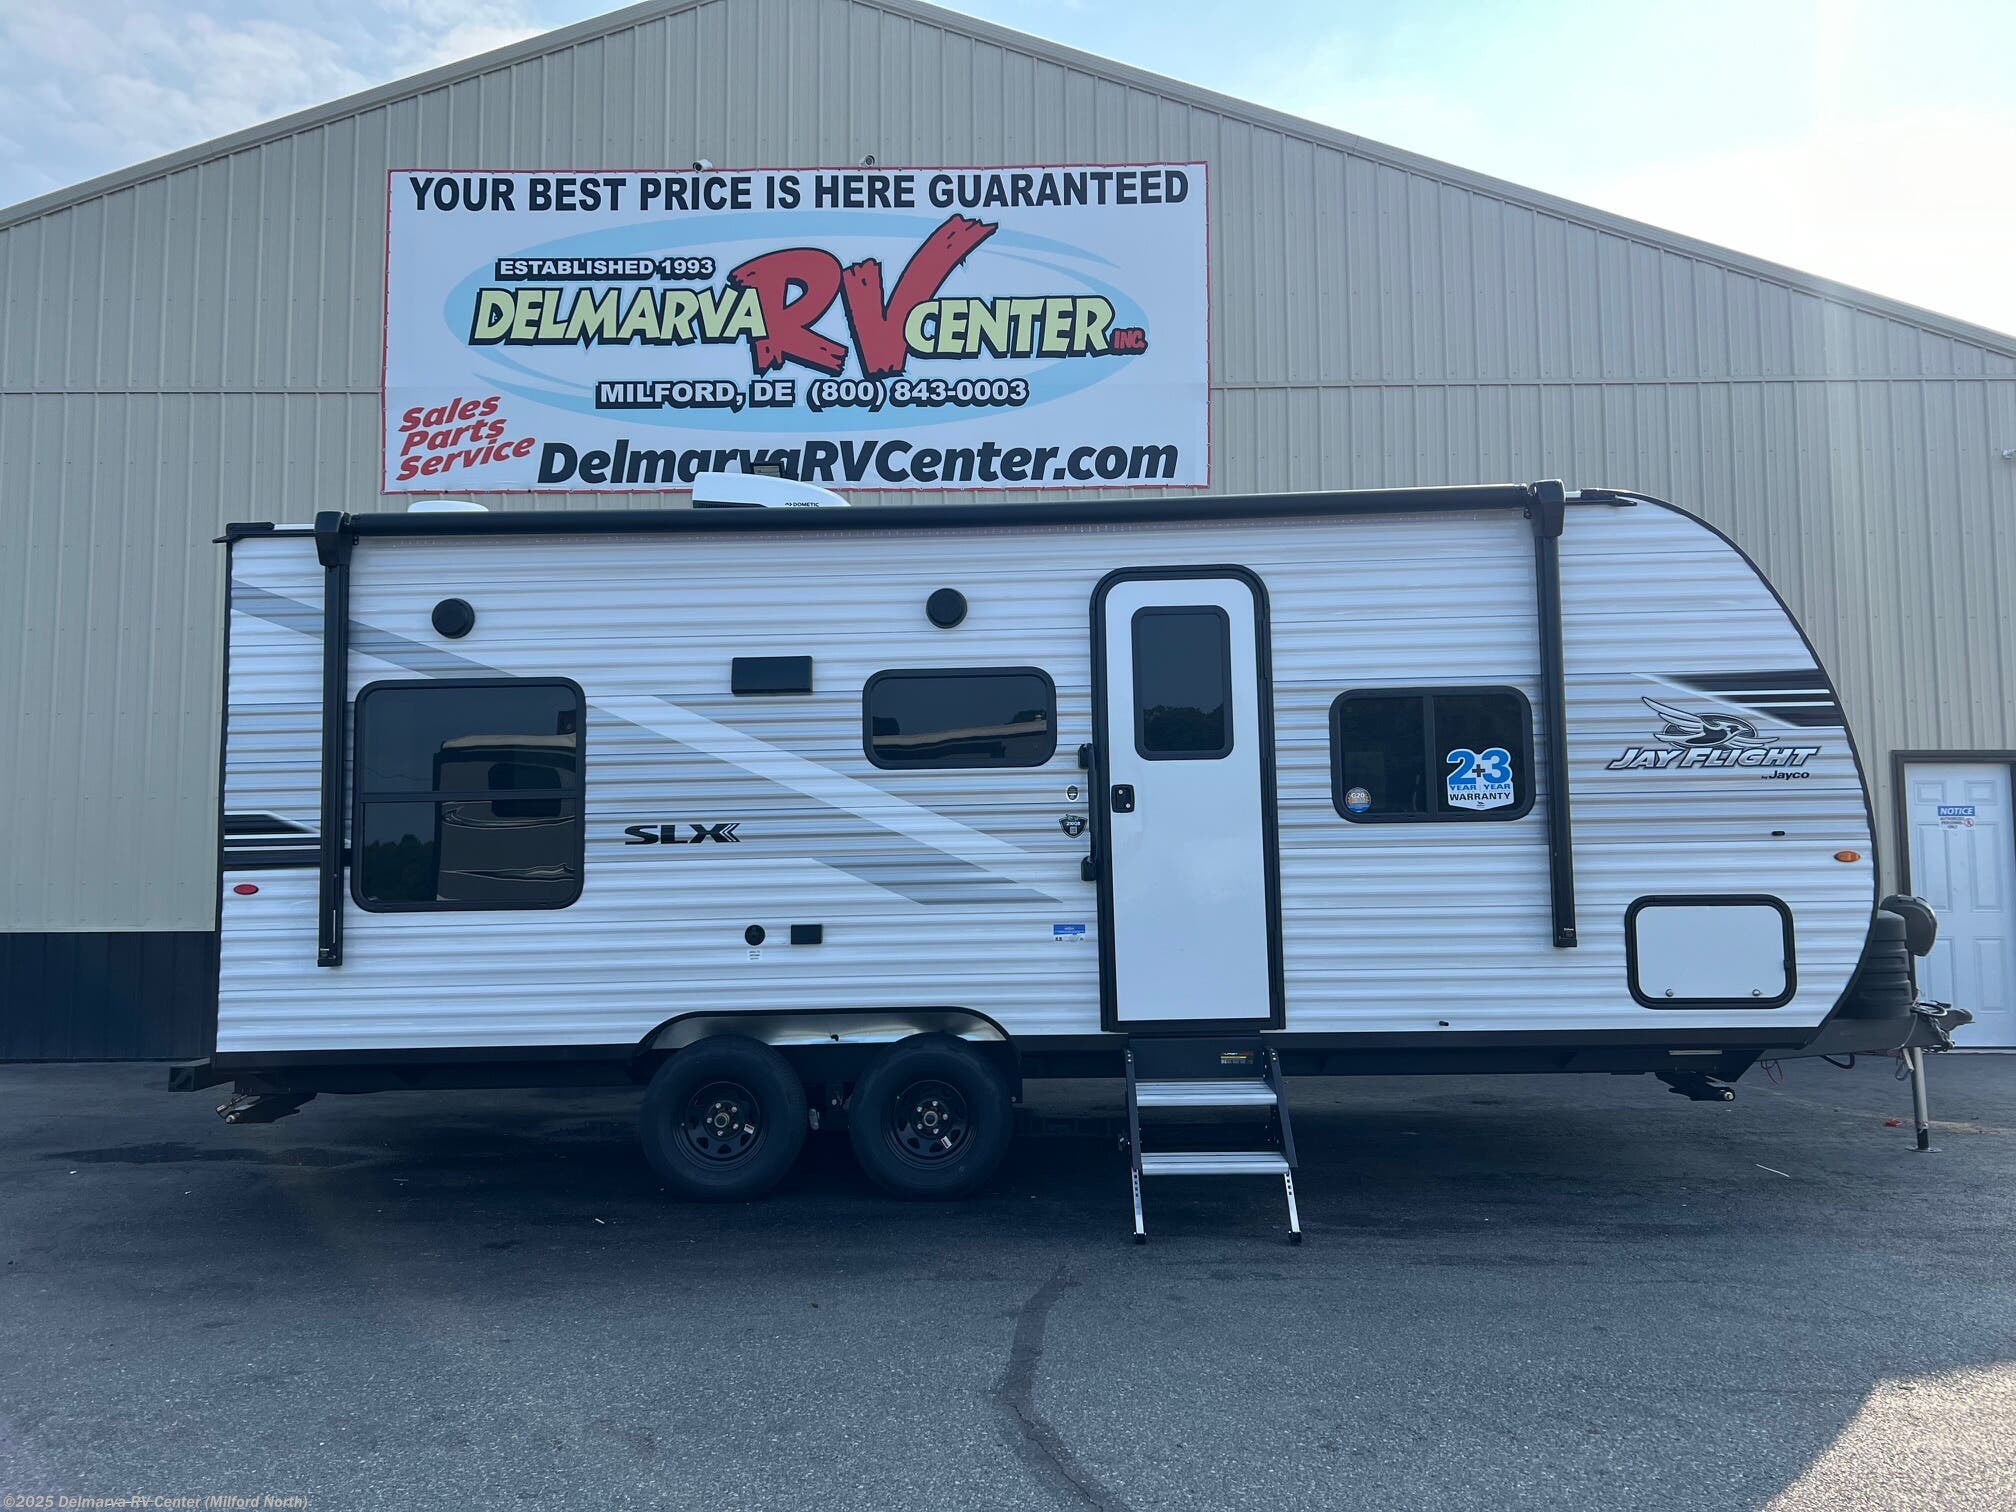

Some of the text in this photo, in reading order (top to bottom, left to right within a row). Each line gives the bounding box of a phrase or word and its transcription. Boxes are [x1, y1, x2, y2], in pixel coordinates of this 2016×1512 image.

[410, 170, 1189, 211] YOUR BEST PRICE IS HERE GUARANTEED
[499, 259, 714, 276] ESTABLISHED 1993
[472, 286, 769, 347] DELMARVA
[727, 213, 999, 377] RV
[904, 296, 1114, 358] CENTER
[600, 380, 1028, 407] MILFORD, DE (800) 843-0003
[398, 396, 501, 432] Sales
[400, 419, 507, 457] Parts
[396, 437, 536, 481] Service
[537, 440, 1179, 484] DelmarvaRVCenter.com
[1605, 746, 1821, 770] JAY FLIGHT
[1769, 770, 1810, 781] Jayco
[1450, 792, 1511, 801] WARRANTY
[1940, 807, 1974, 815] NOTICE
[625, 823, 740, 845] SLX
